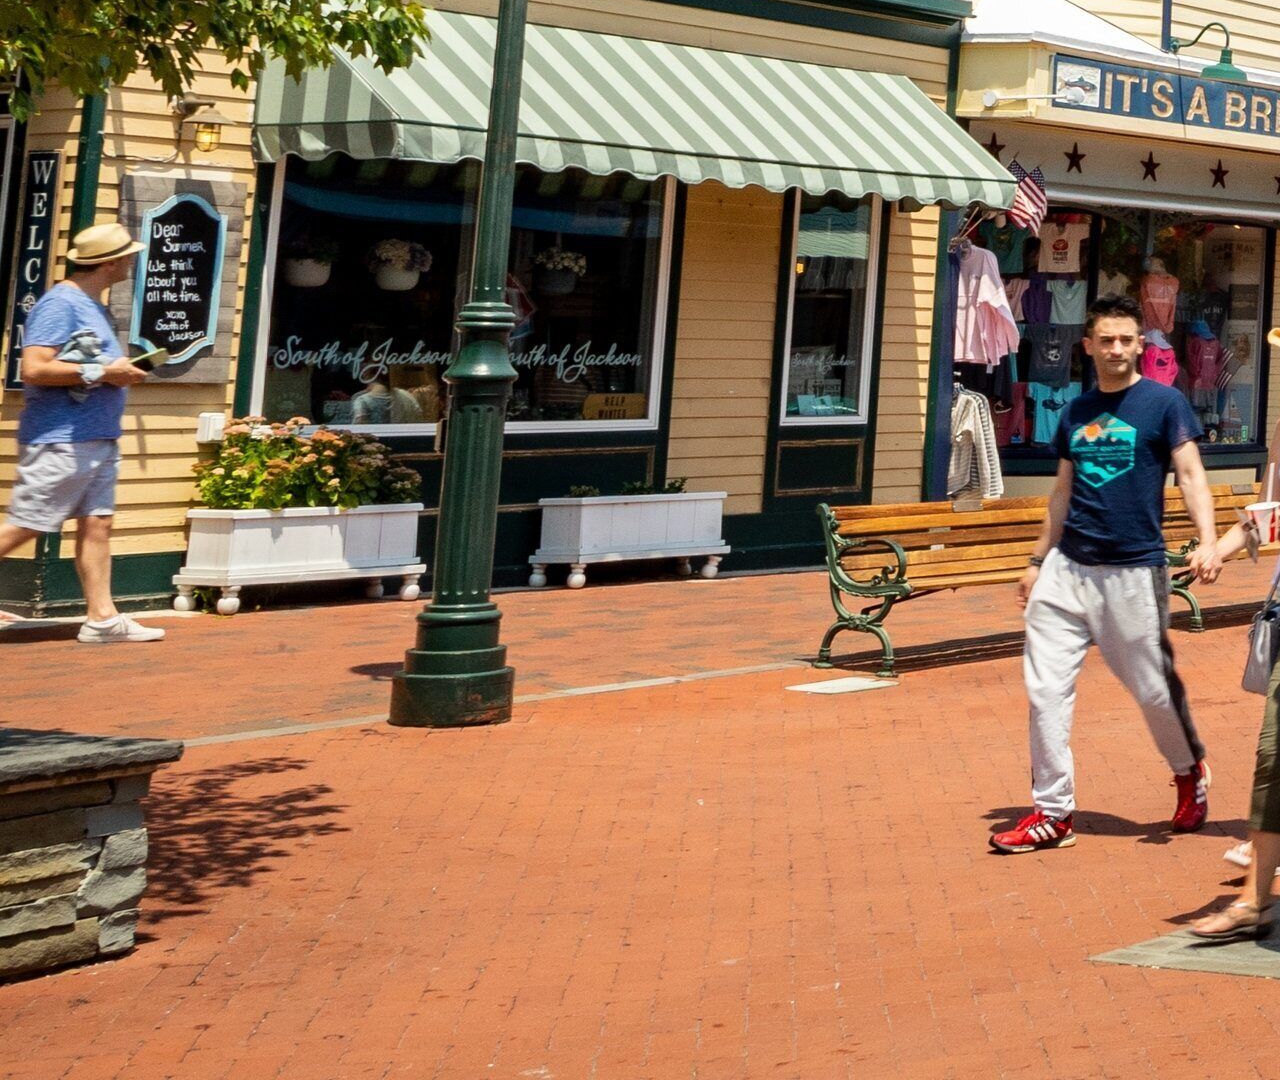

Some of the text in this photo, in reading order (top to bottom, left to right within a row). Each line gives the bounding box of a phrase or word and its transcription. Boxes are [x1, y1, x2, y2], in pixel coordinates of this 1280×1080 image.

[1103, 71, 1174, 119] IT'S
[1185, 85, 1211, 123] A
[153, 222, 184, 239] Dear
[148, 258, 194, 272] We think
[147, 274, 197, 290] about you
[146, 291, 160, 302] all
[162, 291, 178, 302] the
[155, 319, 190, 331] South of
[168, 330, 205, 342] Jackson
[273, 335, 453, 384] South of Jackson
[508, 340, 642, 383] outh of Jackson
